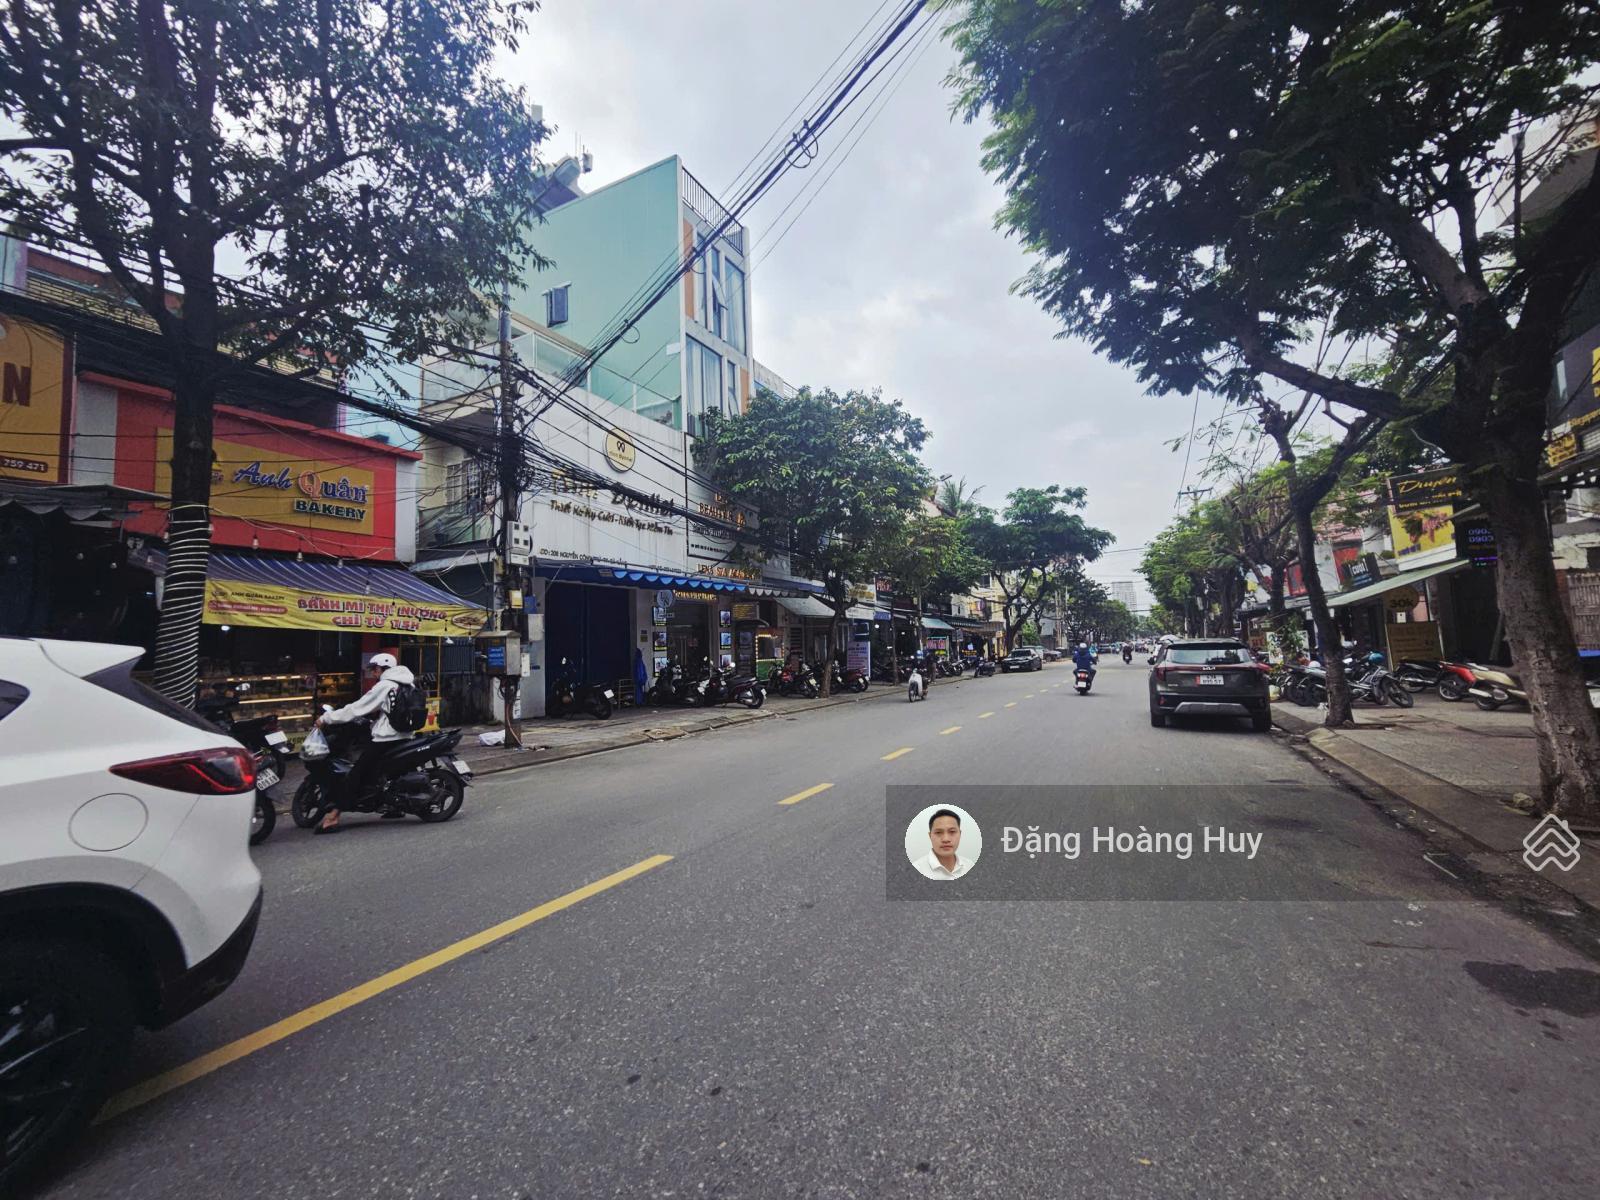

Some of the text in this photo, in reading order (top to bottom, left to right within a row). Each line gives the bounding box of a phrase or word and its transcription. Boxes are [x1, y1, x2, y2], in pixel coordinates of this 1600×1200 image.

[3, 362, 31, 407] N
[232, 460, 368, 505] Anh Quân
[294, 500, 367, 521] BAKERY
[297, 595, 343, 610] BÁNH
[398, 606, 447, 622] NƯỚNG
